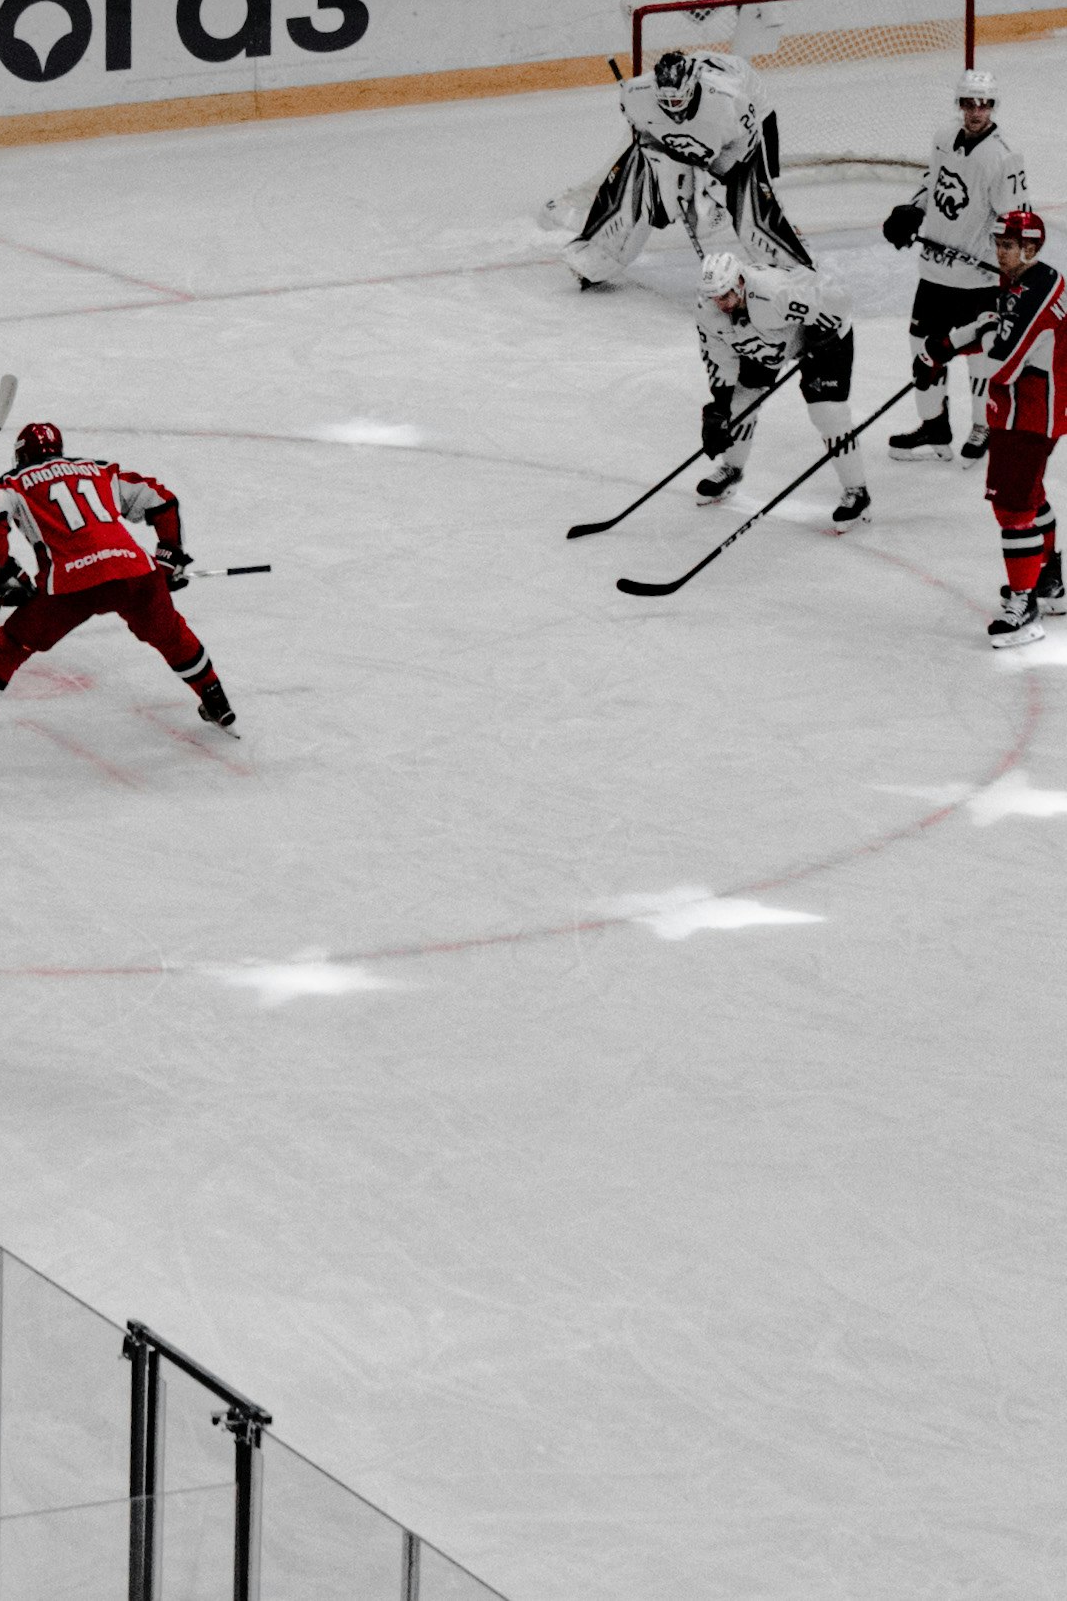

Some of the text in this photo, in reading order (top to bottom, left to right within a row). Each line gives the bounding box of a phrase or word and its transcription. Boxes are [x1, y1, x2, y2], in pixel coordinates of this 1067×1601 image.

[784, 300, 810, 325] 38
[20, 463, 102, 490] ANDRONOV
[49, 478, 113, 532] 11
